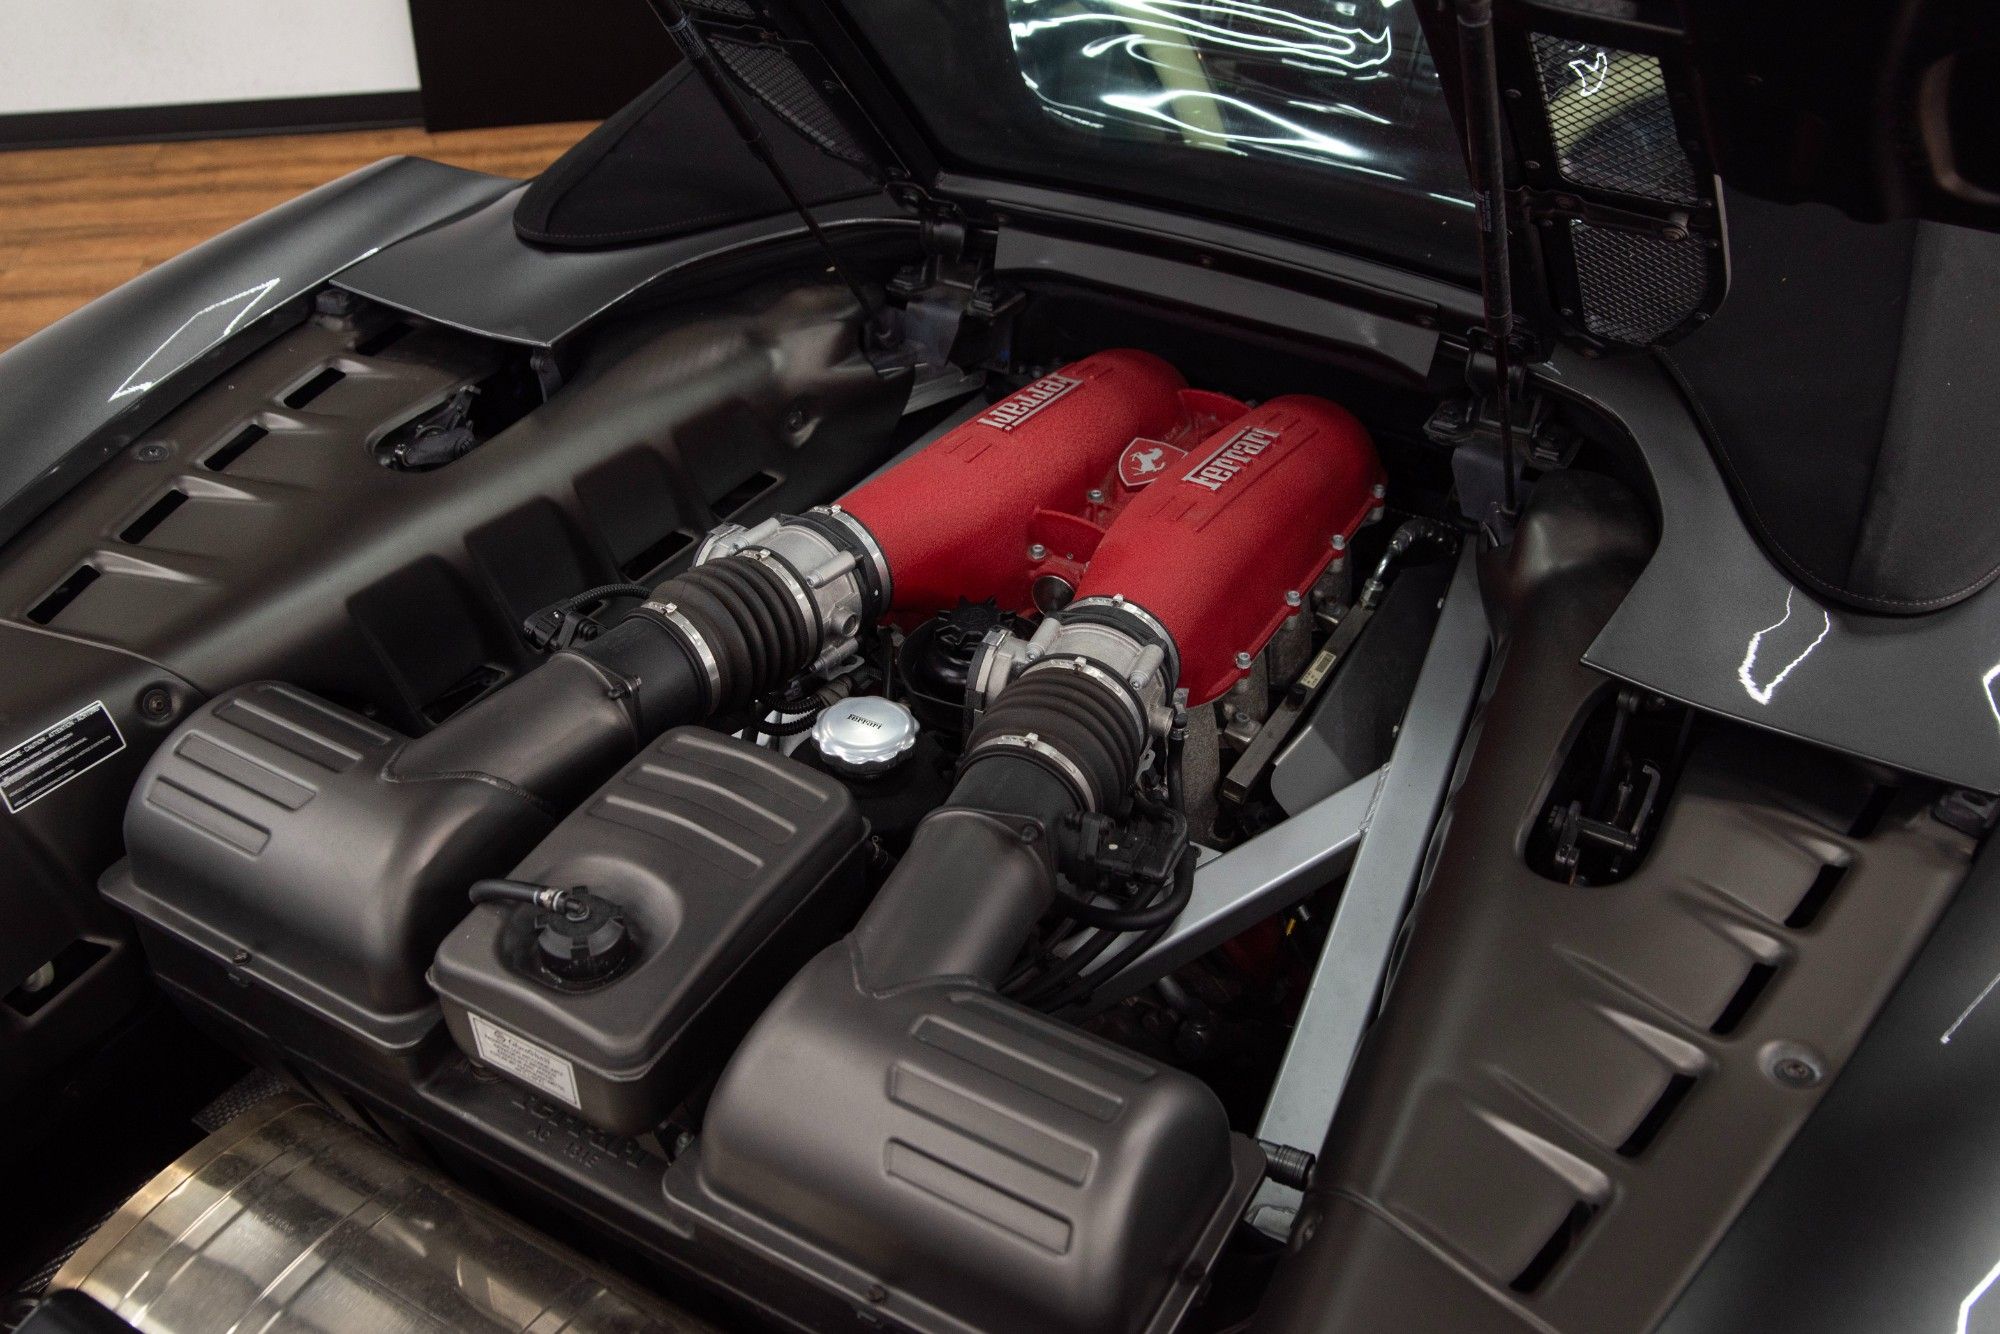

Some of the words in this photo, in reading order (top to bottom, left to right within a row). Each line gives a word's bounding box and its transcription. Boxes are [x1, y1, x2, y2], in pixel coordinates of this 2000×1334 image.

[977, 372, 1084, 431] Ferrari
[1181, 426, 1281, 490] Ferrari
[846, 713, 883, 730] Ferrari
